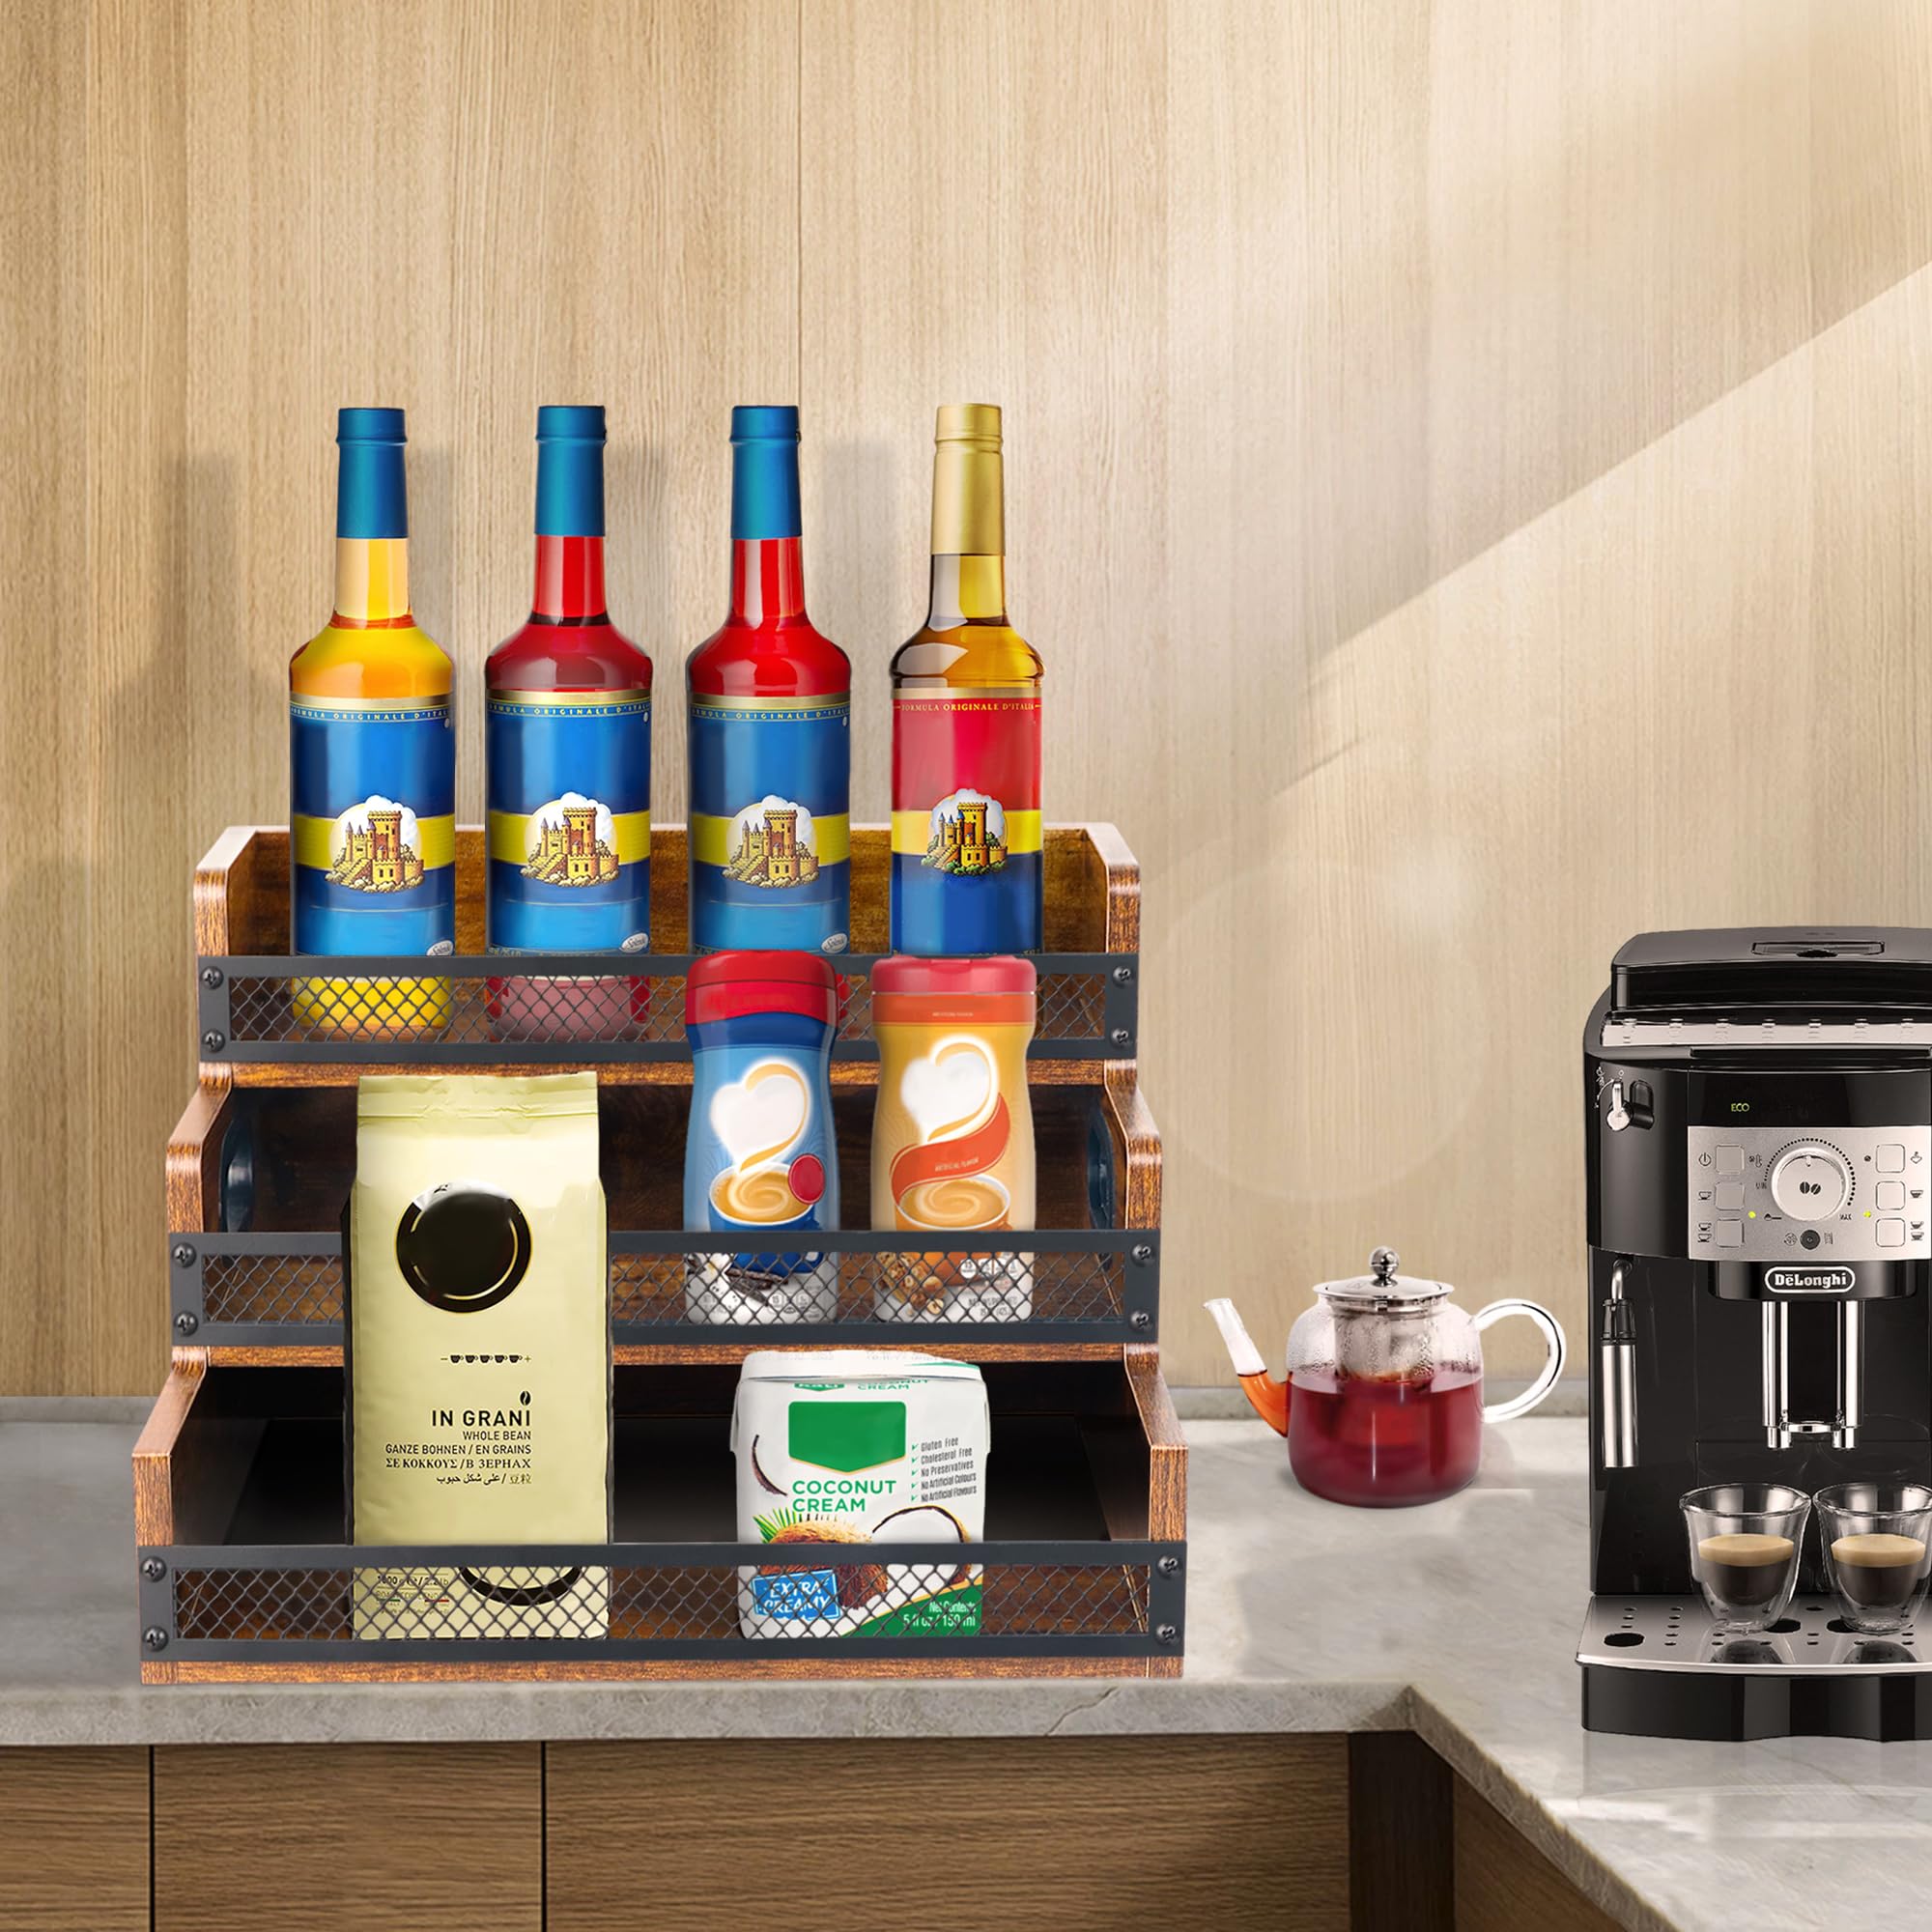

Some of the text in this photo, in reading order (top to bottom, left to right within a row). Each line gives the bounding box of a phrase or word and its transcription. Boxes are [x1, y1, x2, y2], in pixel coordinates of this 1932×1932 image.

[534, 707, 608, 716] ORIGINALE
[901, 702, 1035, 712] FORMULA ORIGINALE D'ITALIA
[333, 712, 405, 721] ORIGINALE
[735, 711, 808, 720] ORIGINALE
[1730, 1102, 1750, 1112] ECO
[432, 1409, 530, 1427] IN GRANI
[463, 1431, 531, 1440] WHOLE BEAN
[385, 1444, 419, 1454] GANZE
[422, 1444, 466, 1454] BOHNEN
[476, 1444, 490, 1454] EN
[493, 1444, 531, 1454] GRAINS
[921, 1437, 958, 1452] Gluten Free
[921, 1447, 973, 1464] Cholesterol Free
[921, 1460, 974, 1477] No Preservatives
[792, 1480, 896, 1494] COCONUT
[921, 1481, 929, 1490] No
[929, 1476, 954, 1489] Artificial
[929, 1489, 952, 1501] Artificial
[792, 1498, 866, 1512] CREAM
[770, 1580, 822, 1599] EXTRA
[764, 1595, 831, 1613] CREAMY
